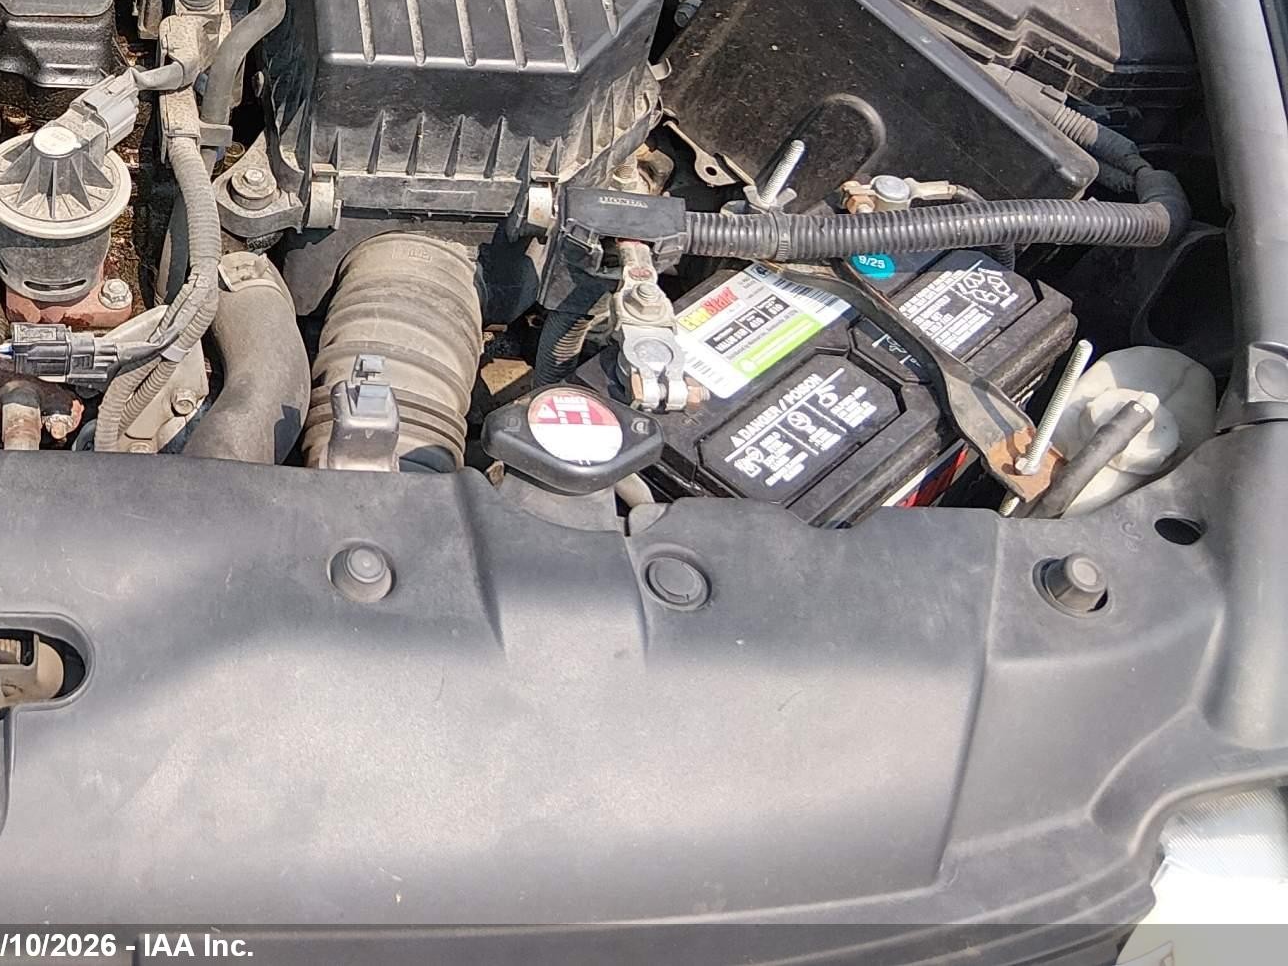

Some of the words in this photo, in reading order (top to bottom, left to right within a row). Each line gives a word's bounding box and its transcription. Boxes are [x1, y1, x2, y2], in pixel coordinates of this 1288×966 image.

[599, 196, 649, 209] HONDA
[859, 255, 886, 270] 9/25
[740, 404, 783, 441] DANGER
[785, 373, 824, 405] POISON
